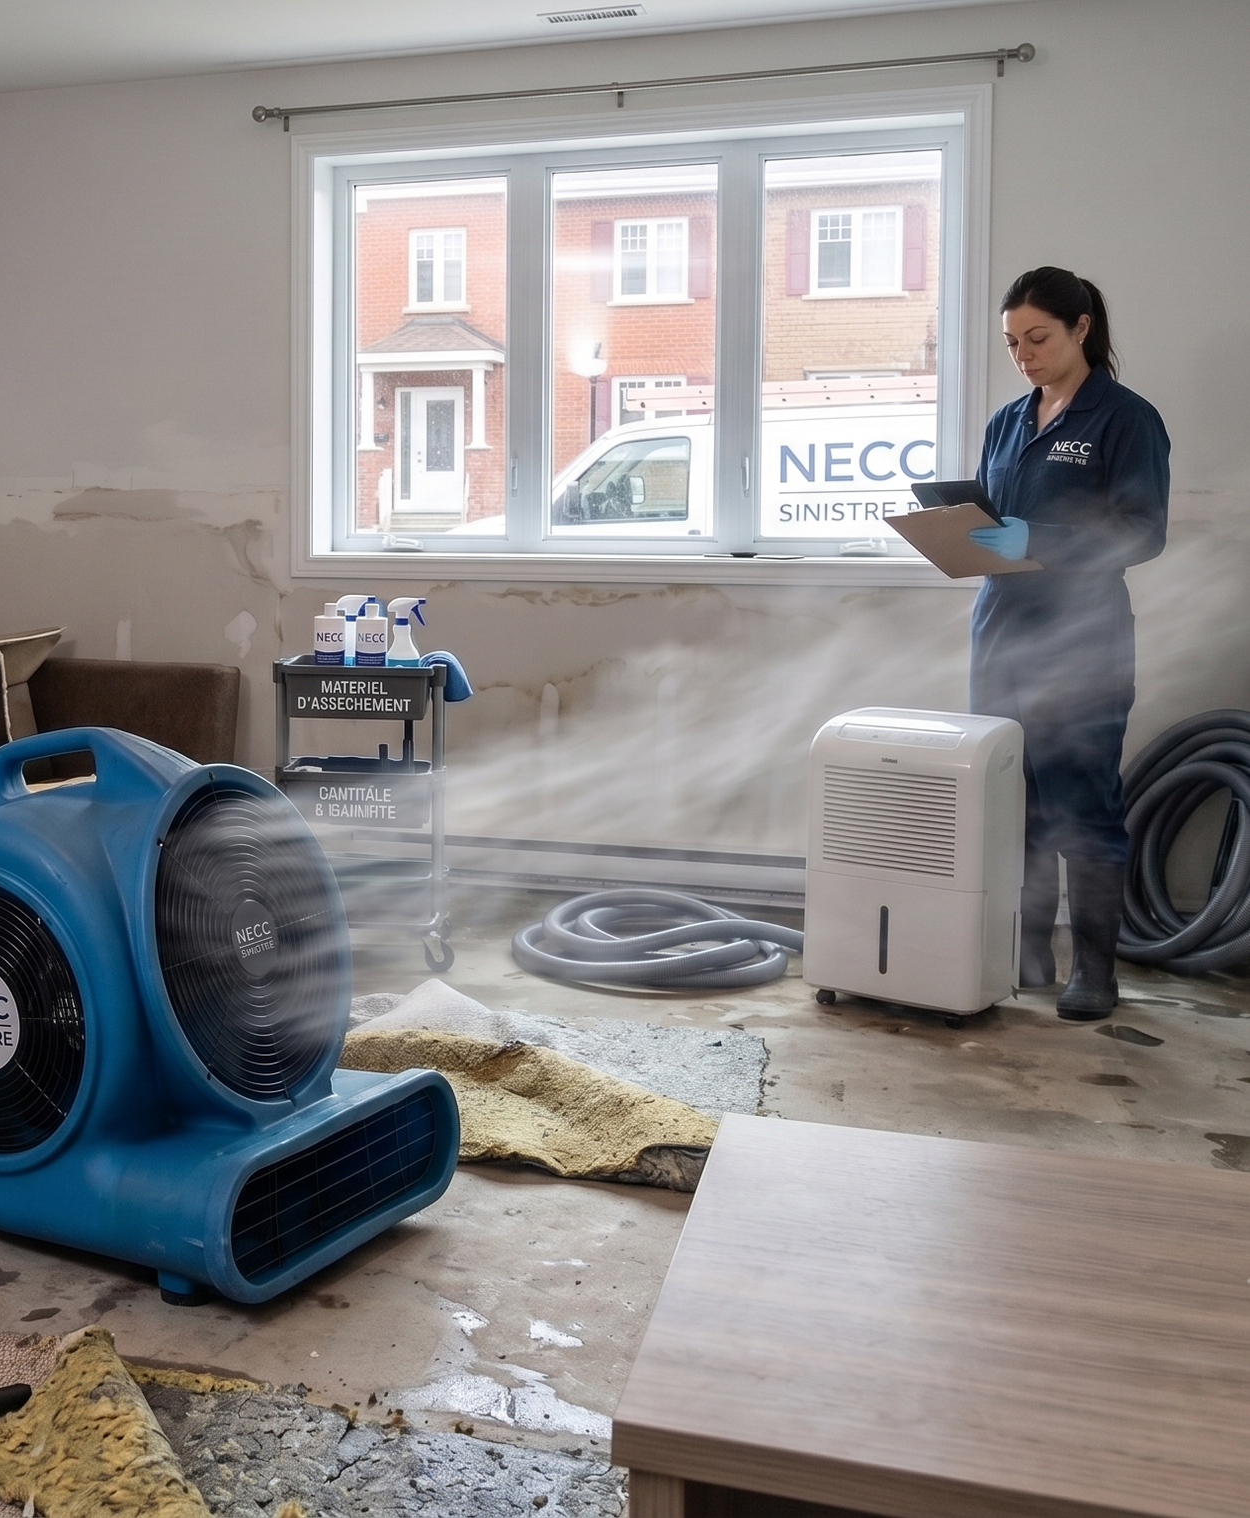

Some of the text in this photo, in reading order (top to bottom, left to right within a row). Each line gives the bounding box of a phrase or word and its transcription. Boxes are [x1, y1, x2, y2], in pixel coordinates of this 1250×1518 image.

[1050, 441, 1093, 455] NECC
[780, 440, 936, 483] NECC
[779, 501, 897, 522] SINISTRE
[316, 632, 343, 643] NECC
[357, 632, 385, 643] NECC
[321, 680, 388, 695] MATERIEL
[297, 696, 412, 712] D'ASSECHEMENT
[235, 921, 271, 944] NECC
